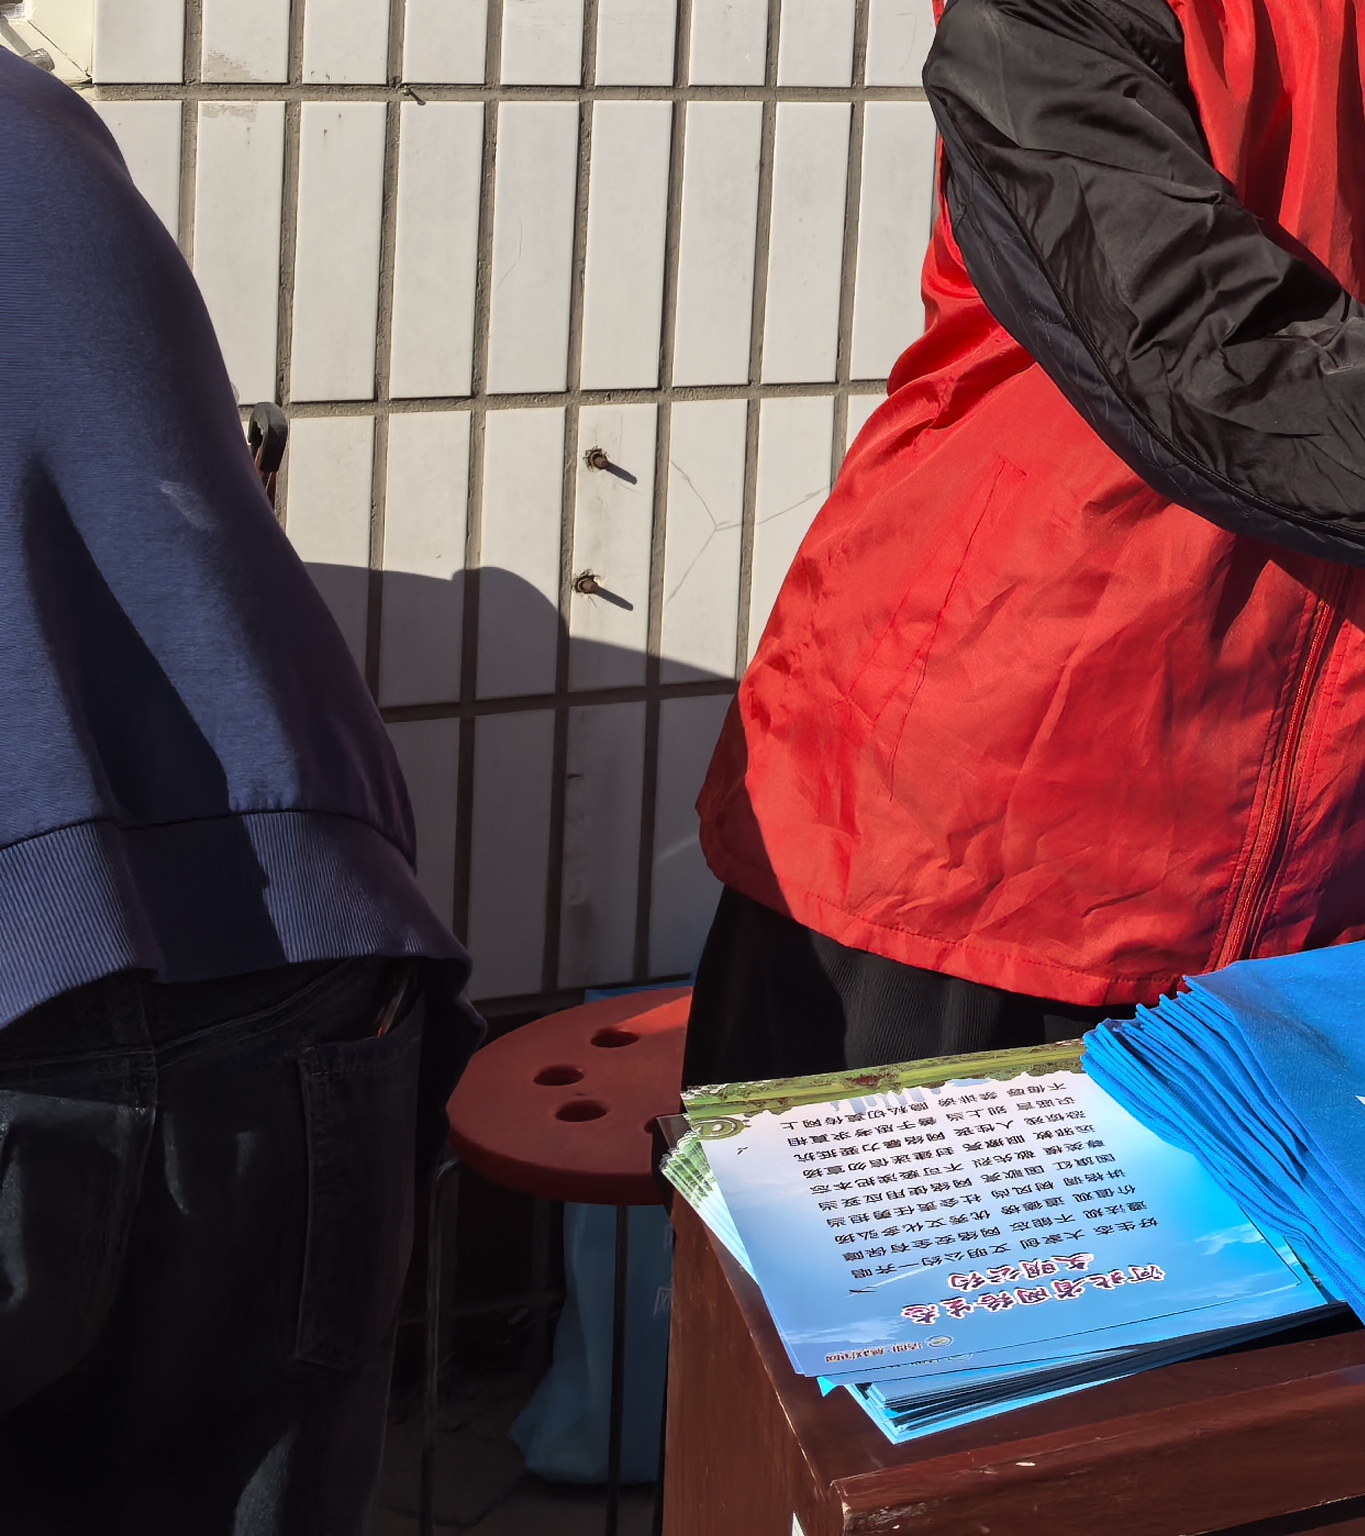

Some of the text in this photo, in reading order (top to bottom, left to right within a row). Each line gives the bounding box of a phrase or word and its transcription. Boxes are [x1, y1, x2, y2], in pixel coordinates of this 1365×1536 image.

[826, 1167, 1125, 1226] 讲格调 树风尚 社会责任勇担当
[1072, 1183, 1136, 1202] 价值观
[834, 1207, 991, 1243] 优秀文化多弘扬
[1009, 1211, 1075, 1232] 不能忘
[842, 1225, 1001, 1260] 网络安全有保障
[850, 1216, 1158, 1278] 好生态 大家创 文明公约一齐唱
[948, 1251, 1094, 1290] 文明公约
[901, 1262, 1166, 1324] 河北省网络生态
